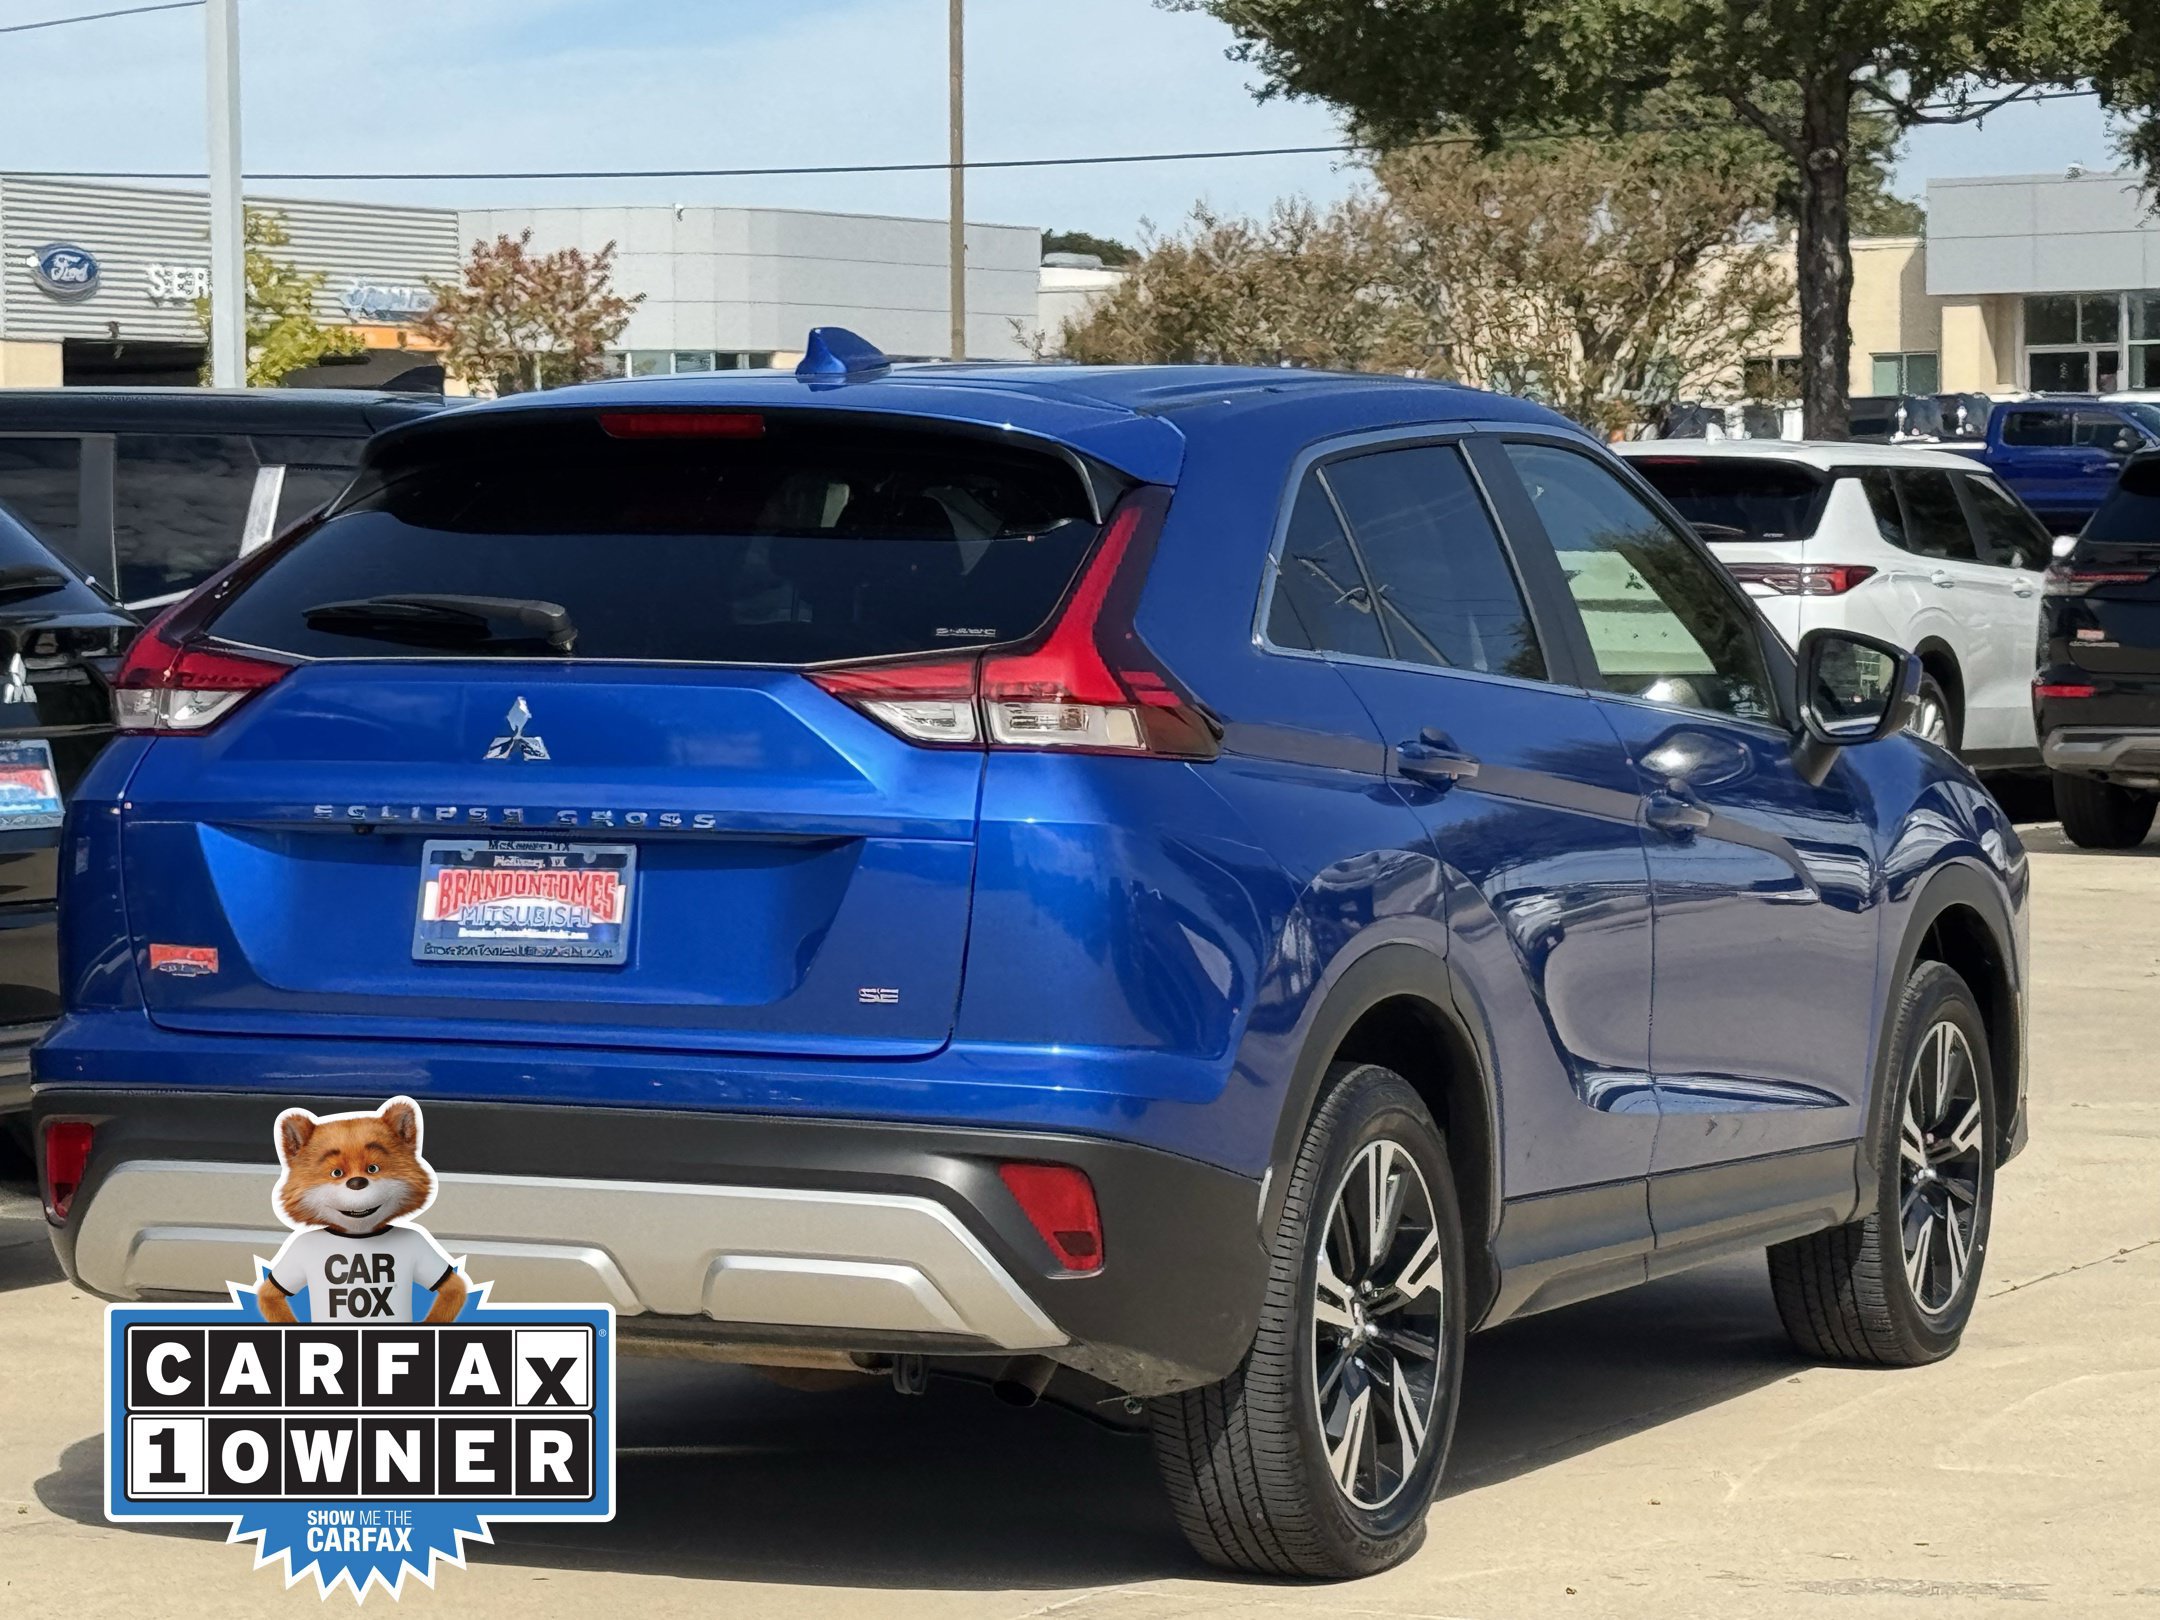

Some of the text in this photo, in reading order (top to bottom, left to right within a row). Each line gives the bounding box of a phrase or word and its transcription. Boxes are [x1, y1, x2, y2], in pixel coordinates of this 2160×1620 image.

[50, 253, 90, 283] Ford
[313, 804, 717, 829] ECLIPSE CROSS
[859, 988, 899, 1003] SE
